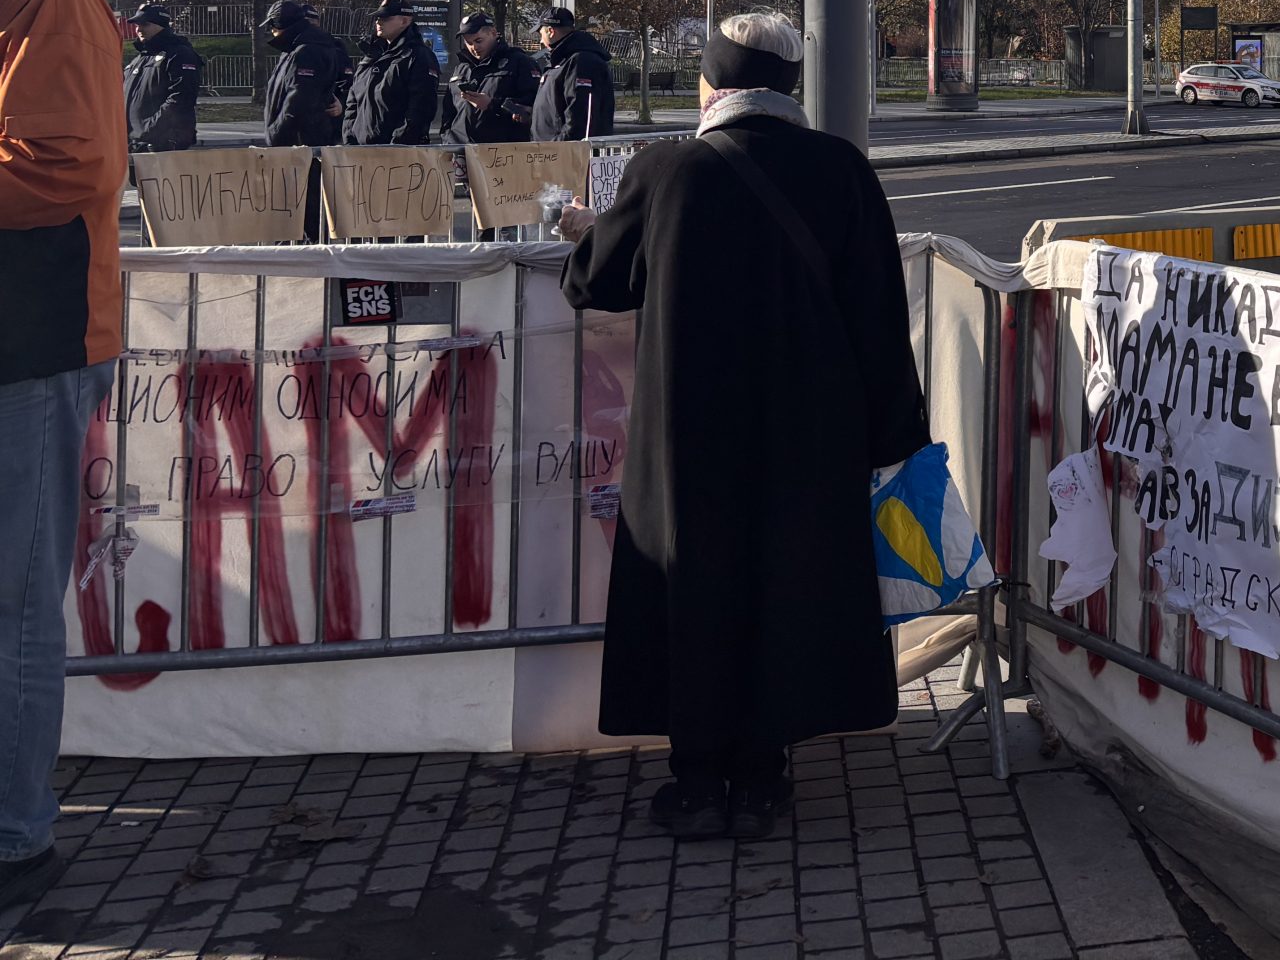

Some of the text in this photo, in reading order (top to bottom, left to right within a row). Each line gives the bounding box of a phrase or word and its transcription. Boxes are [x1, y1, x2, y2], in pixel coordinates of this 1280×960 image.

[1093, 250, 1145, 305] ДА
[347, 284, 390, 303] FCK
[347, 299, 391, 318] SNS
